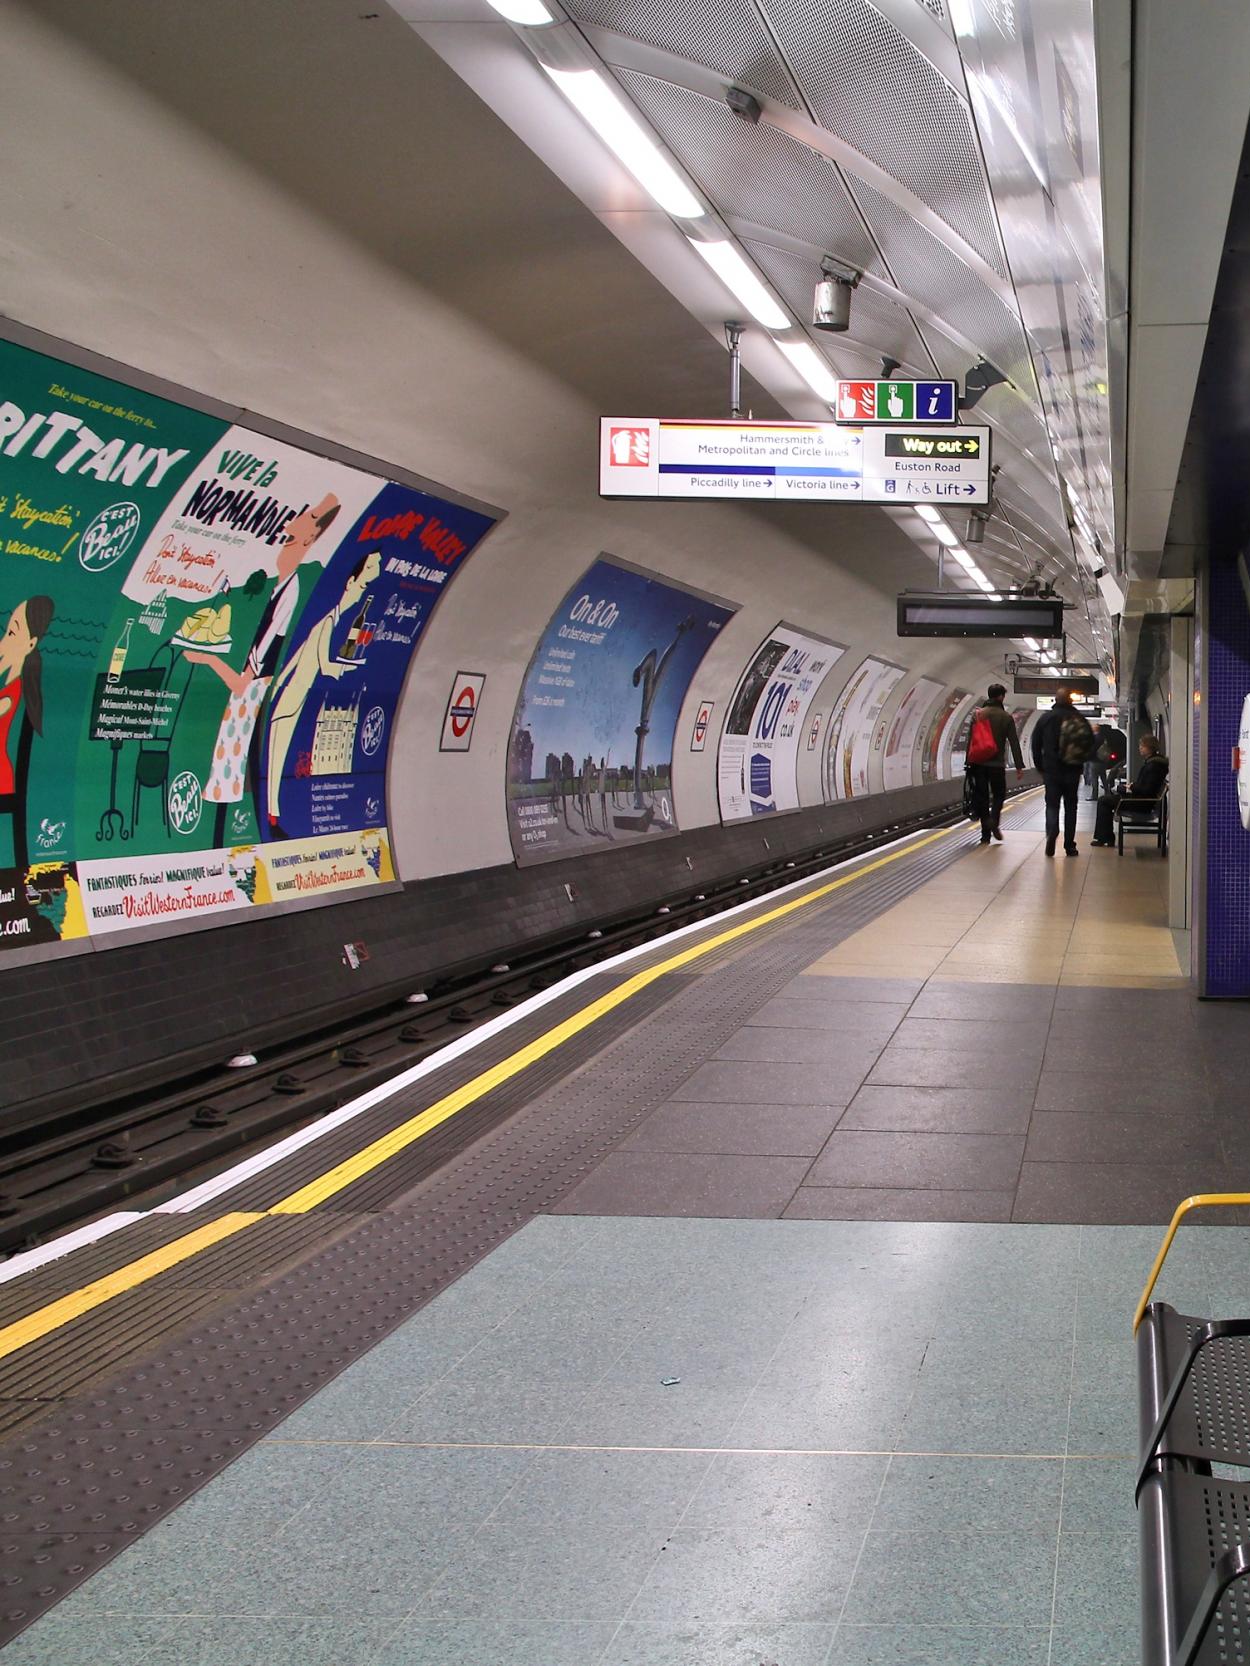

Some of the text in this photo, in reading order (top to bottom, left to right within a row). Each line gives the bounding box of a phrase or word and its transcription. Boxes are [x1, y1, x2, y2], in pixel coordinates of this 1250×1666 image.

[48, 384, 69, 398] Take
[88, 400, 103, 409] car
[740, 434, 814, 445] Hammersmith
[817, 435, 824, 445] &
[903, 438, 962, 455] Way out
[698, 444, 849, 457] Metropolitan and Circle lines
[217, 450, 279, 488] VIVE la
[895, 461, 961, 473] Euston Road
[690, 477, 761, 489] Piccadilly line
[786, 479, 849, 490] Victoria line
[936, 482, 960, 496] Lift
[101, 507, 134, 522] C'EST
[569, 594, 619, 629] On & On
[104, 685, 128, 696] Monet's
[129, 689, 144, 697] water
[138, 703, 153, 713] D-Day
[755, 681, 792, 740] 101
[98, 713, 124, 726] Magical
[133, 731, 153, 739] markets
[36, 832, 63, 848] France
[87, 874, 137, 891] FANTASTIQUES
[166, 866, 205, 882] MAGNIFIQUE
[92, 886, 236, 918] REGARDEZ VisitWesternFrance.com
